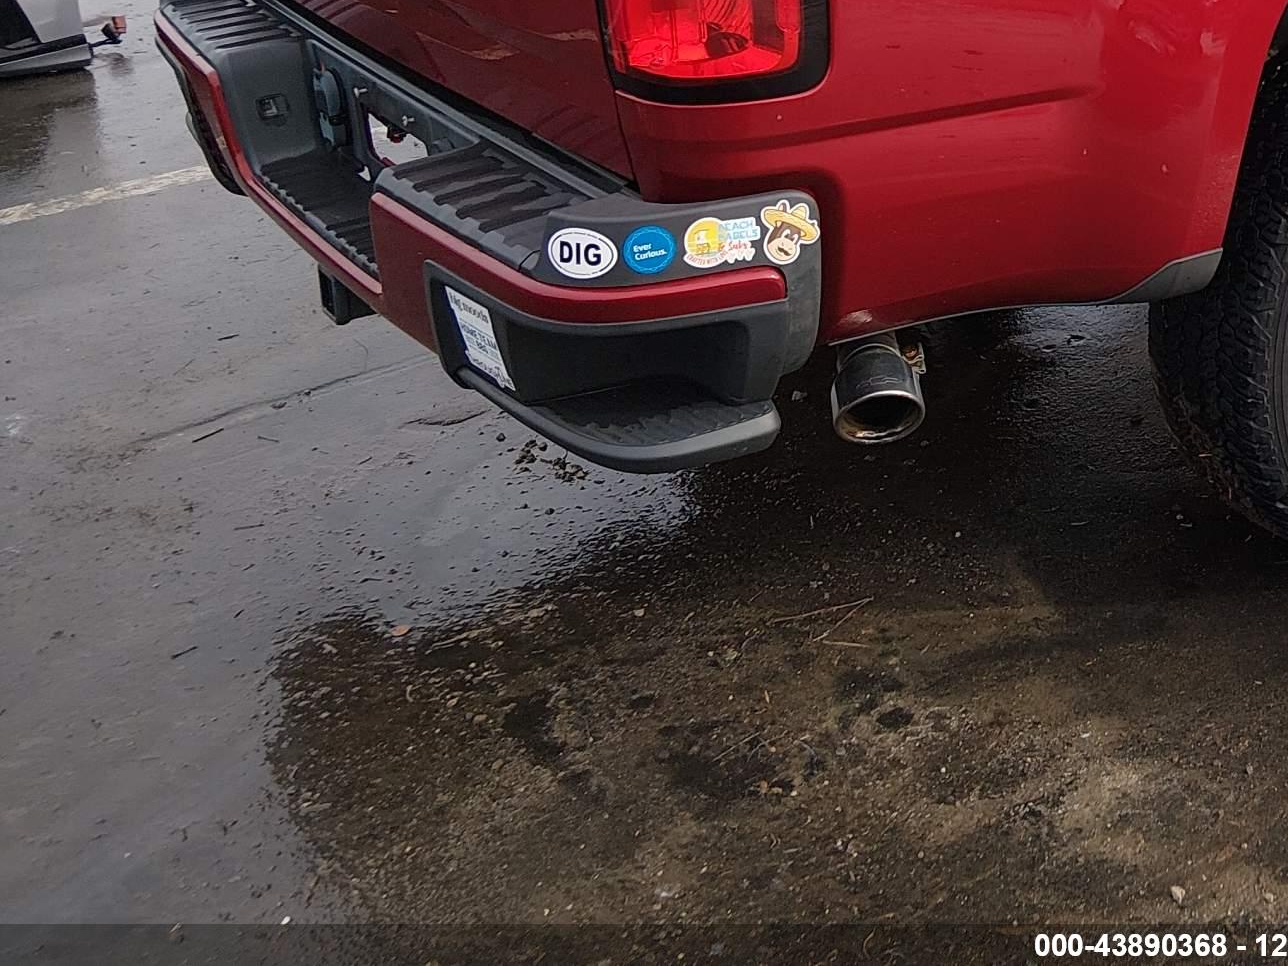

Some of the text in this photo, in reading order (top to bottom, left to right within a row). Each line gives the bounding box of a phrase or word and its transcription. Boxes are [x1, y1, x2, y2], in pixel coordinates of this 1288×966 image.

[560, 240, 602, 266] DIG
[633, 243, 652, 253] Ever
[634, 249, 668, 261] Curious.
